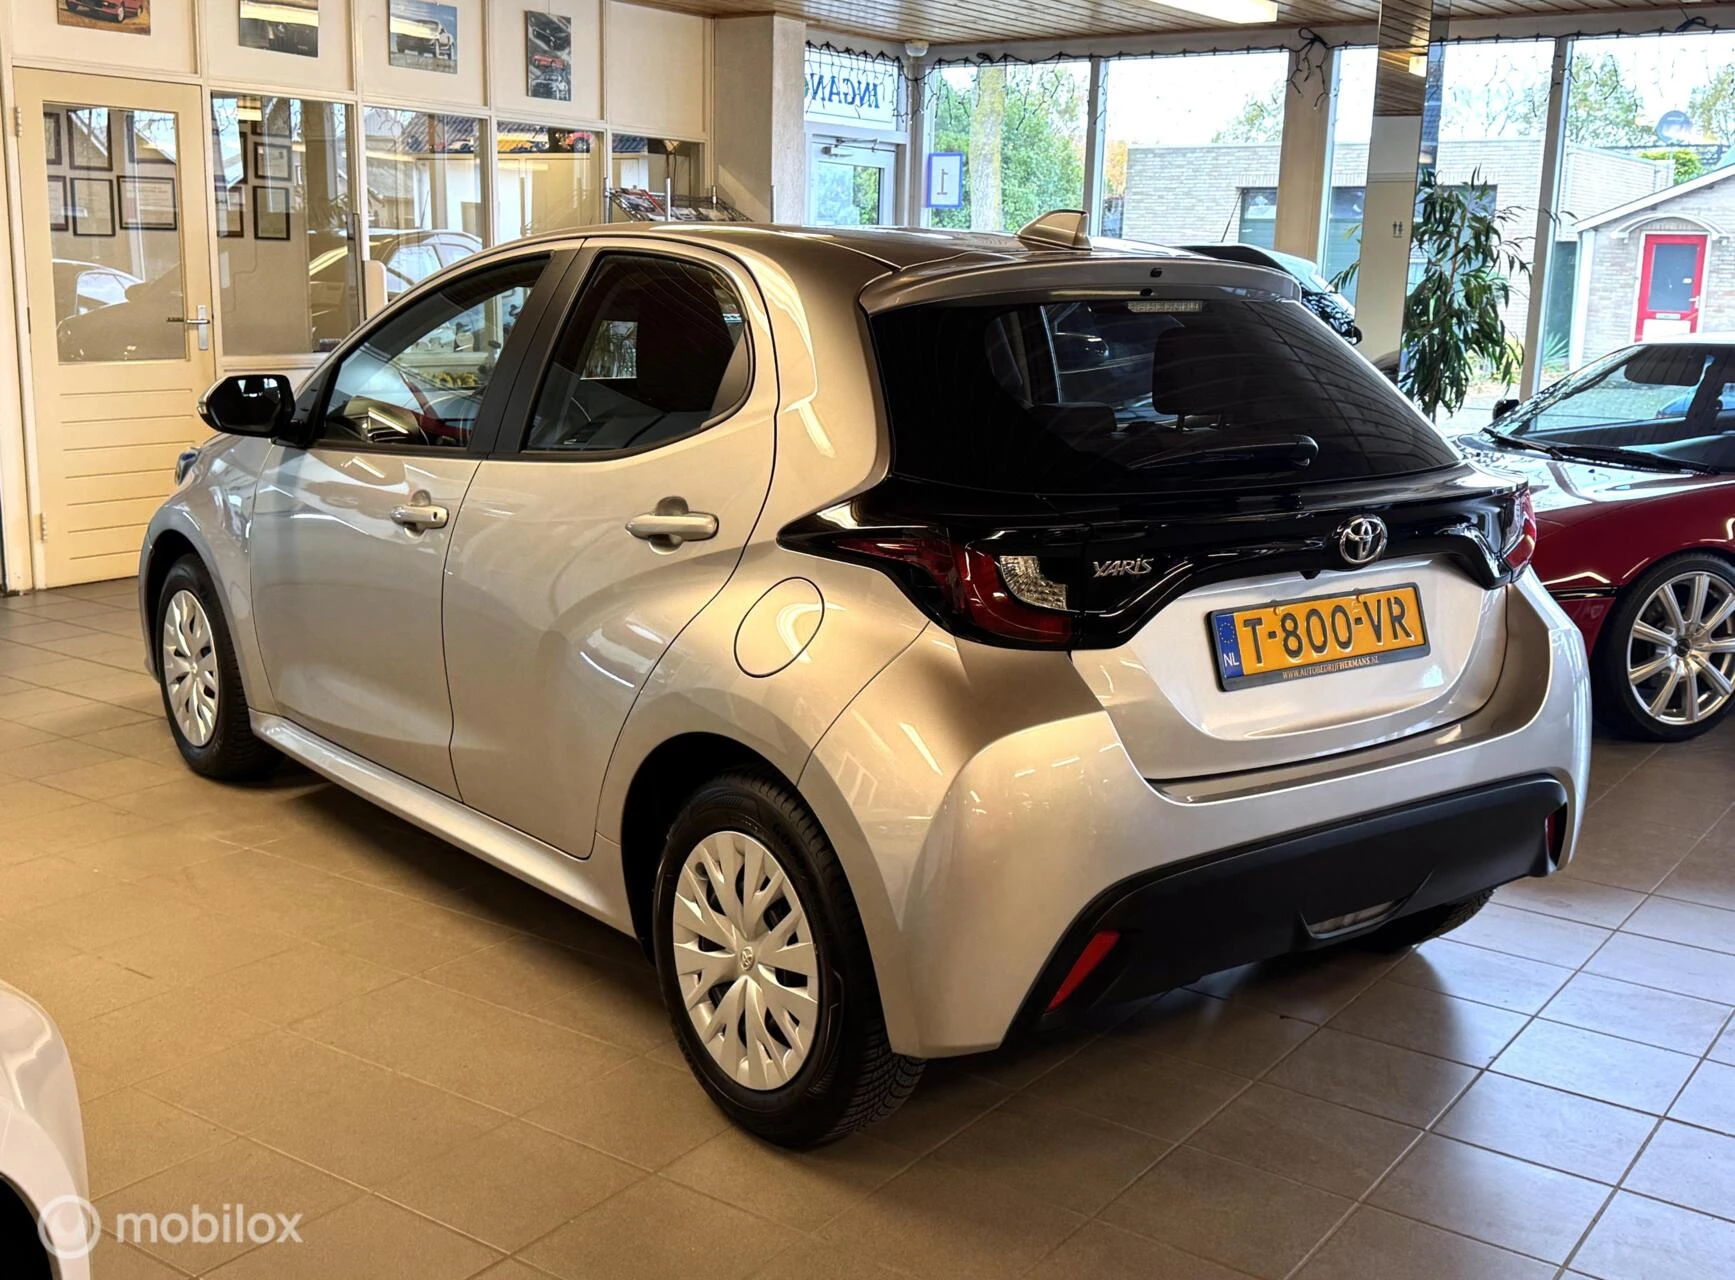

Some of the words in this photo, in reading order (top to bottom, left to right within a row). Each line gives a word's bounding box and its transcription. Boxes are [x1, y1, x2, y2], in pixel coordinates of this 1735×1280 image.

[1093, 554, 1154, 578] YARIS
[1243, 596, 1413, 666] T-800-VR
[1224, 652, 1239, 667] NL
